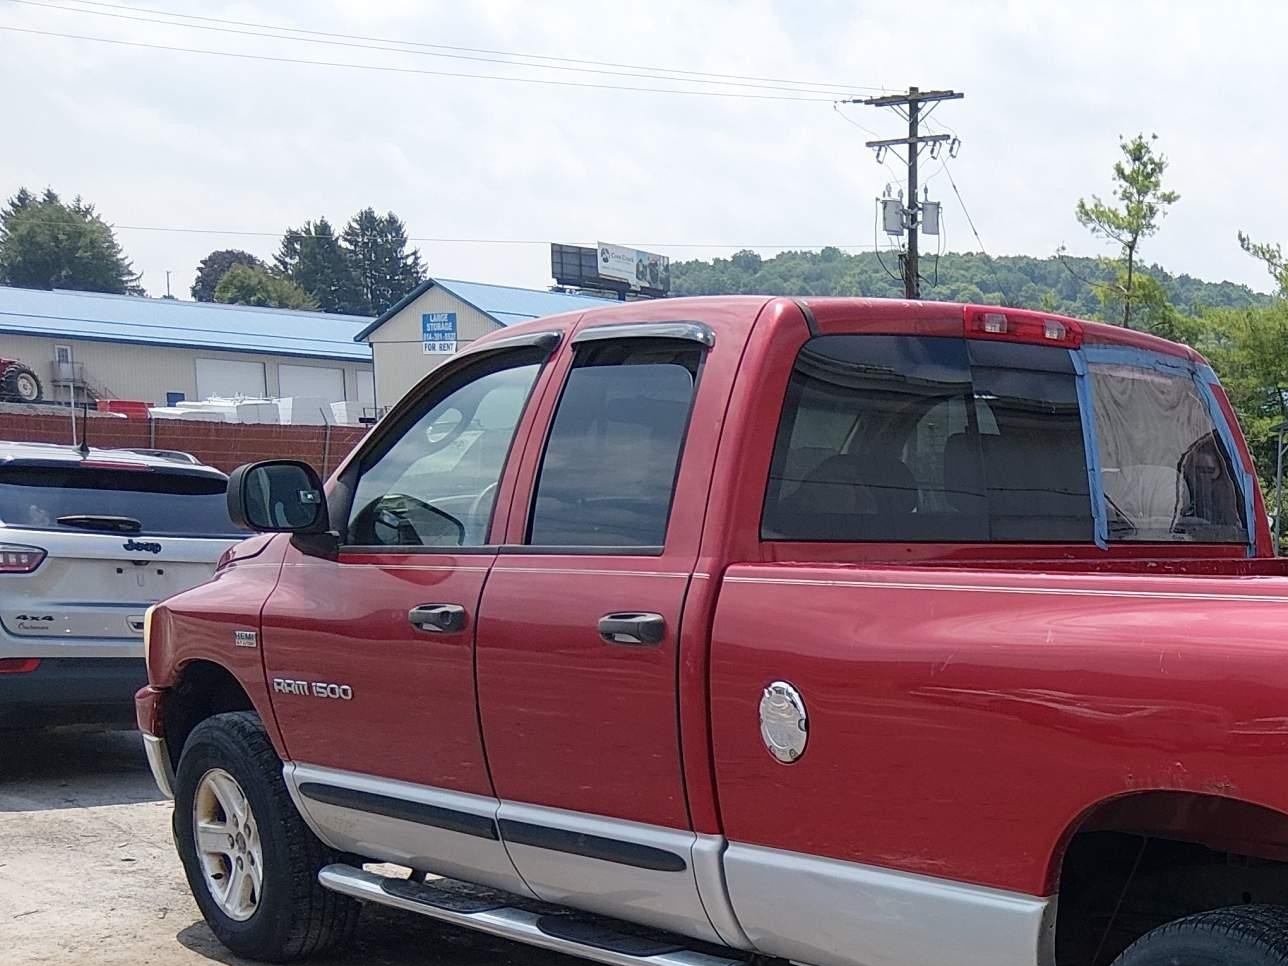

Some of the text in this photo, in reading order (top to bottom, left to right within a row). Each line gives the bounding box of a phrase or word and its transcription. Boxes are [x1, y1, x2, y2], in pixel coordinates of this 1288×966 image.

[430, 313, 449, 322] LARGE
[426, 322, 453, 331] STORAGE
[424, 342, 454, 352] FOR RENT
[123, 539, 162, 554] Jeep
[273, 678, 353, 700] RAM 1500
